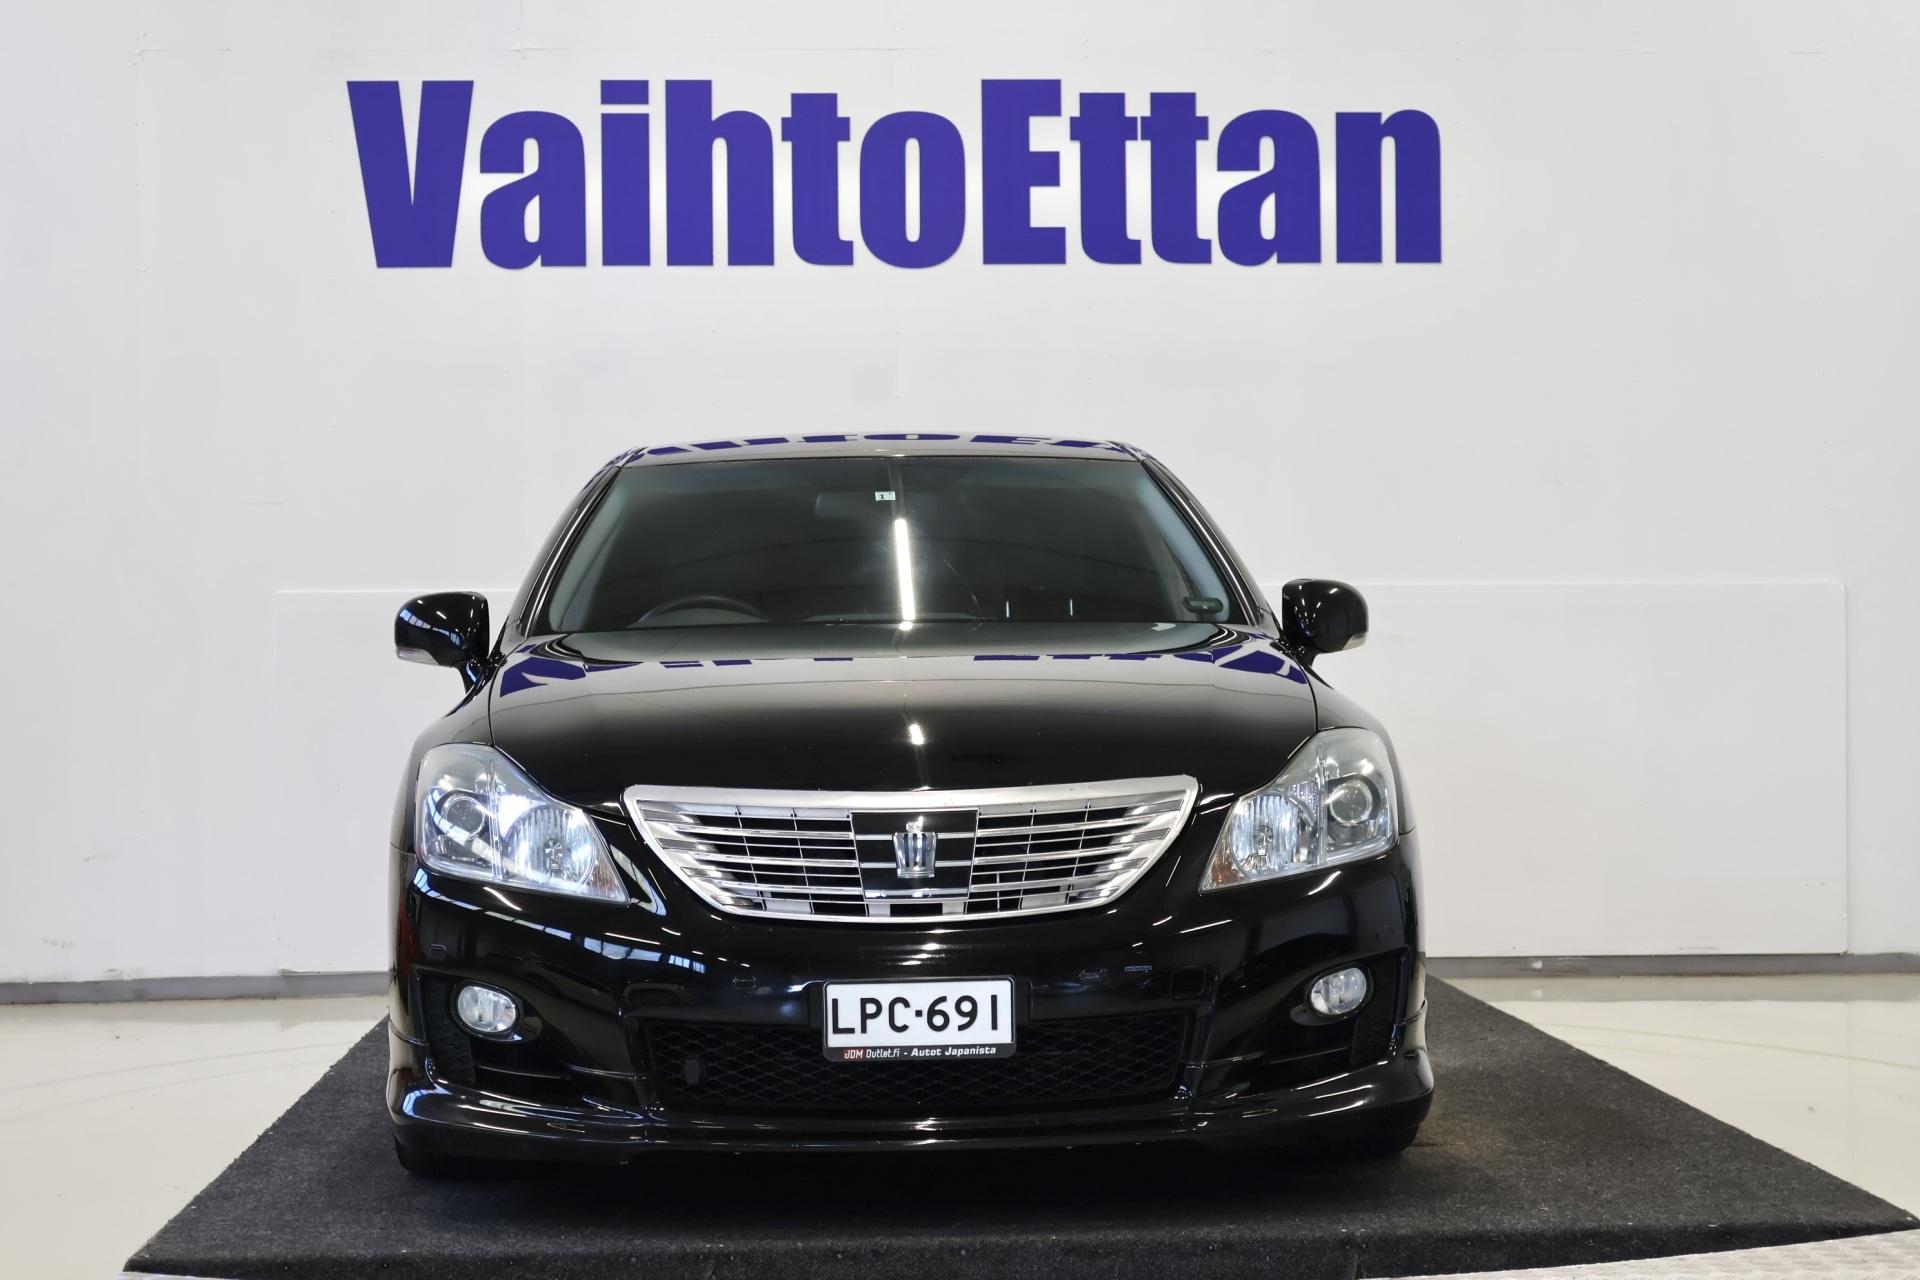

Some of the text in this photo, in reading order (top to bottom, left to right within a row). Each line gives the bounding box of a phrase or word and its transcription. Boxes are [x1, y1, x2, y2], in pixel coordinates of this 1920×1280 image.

[348, 80, 1441, 268] VaihtoEttan
[844, 1049, 863, 1059] JDM
[911, 1048, 941, 1057] Autot
[945, 1046, 996, 1057] Japanista
